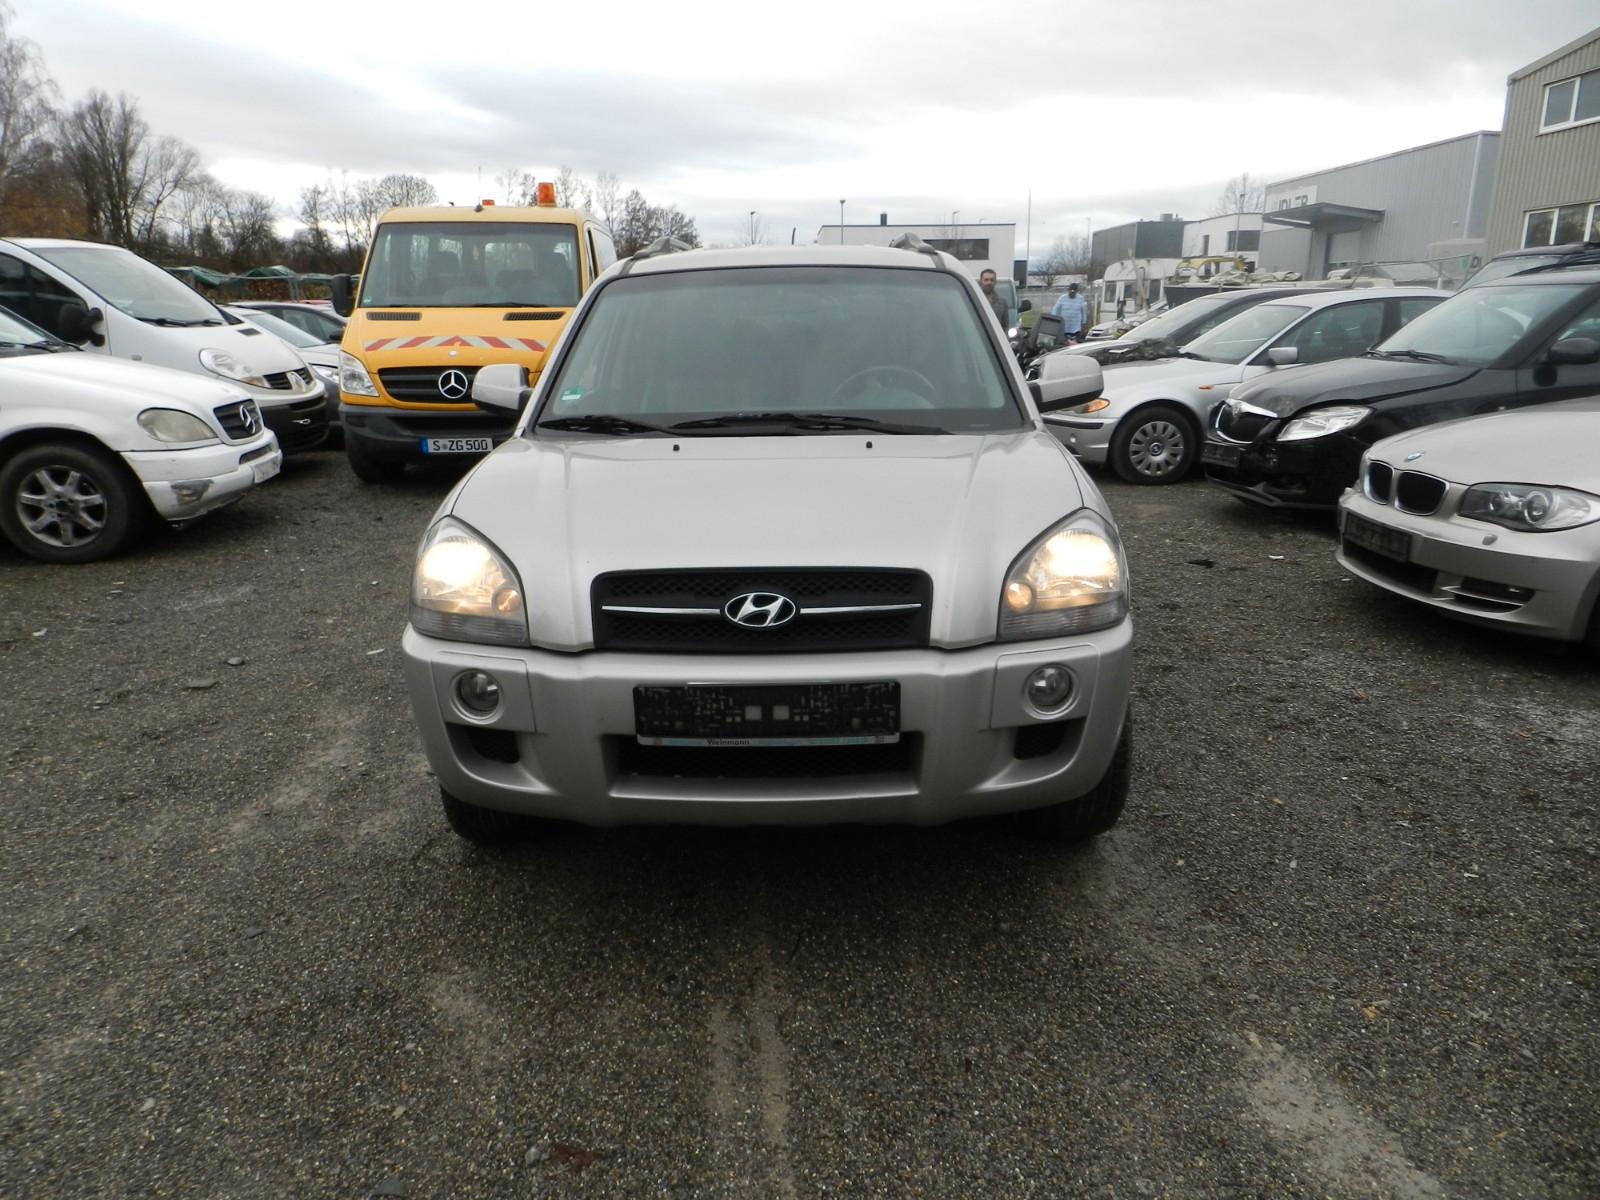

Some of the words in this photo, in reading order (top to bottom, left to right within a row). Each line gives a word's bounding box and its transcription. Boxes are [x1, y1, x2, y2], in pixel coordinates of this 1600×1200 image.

[432, 440, 441, 451] S
[448, 439, 464, 451] ZG
[465, 439, 488, 451] 500
